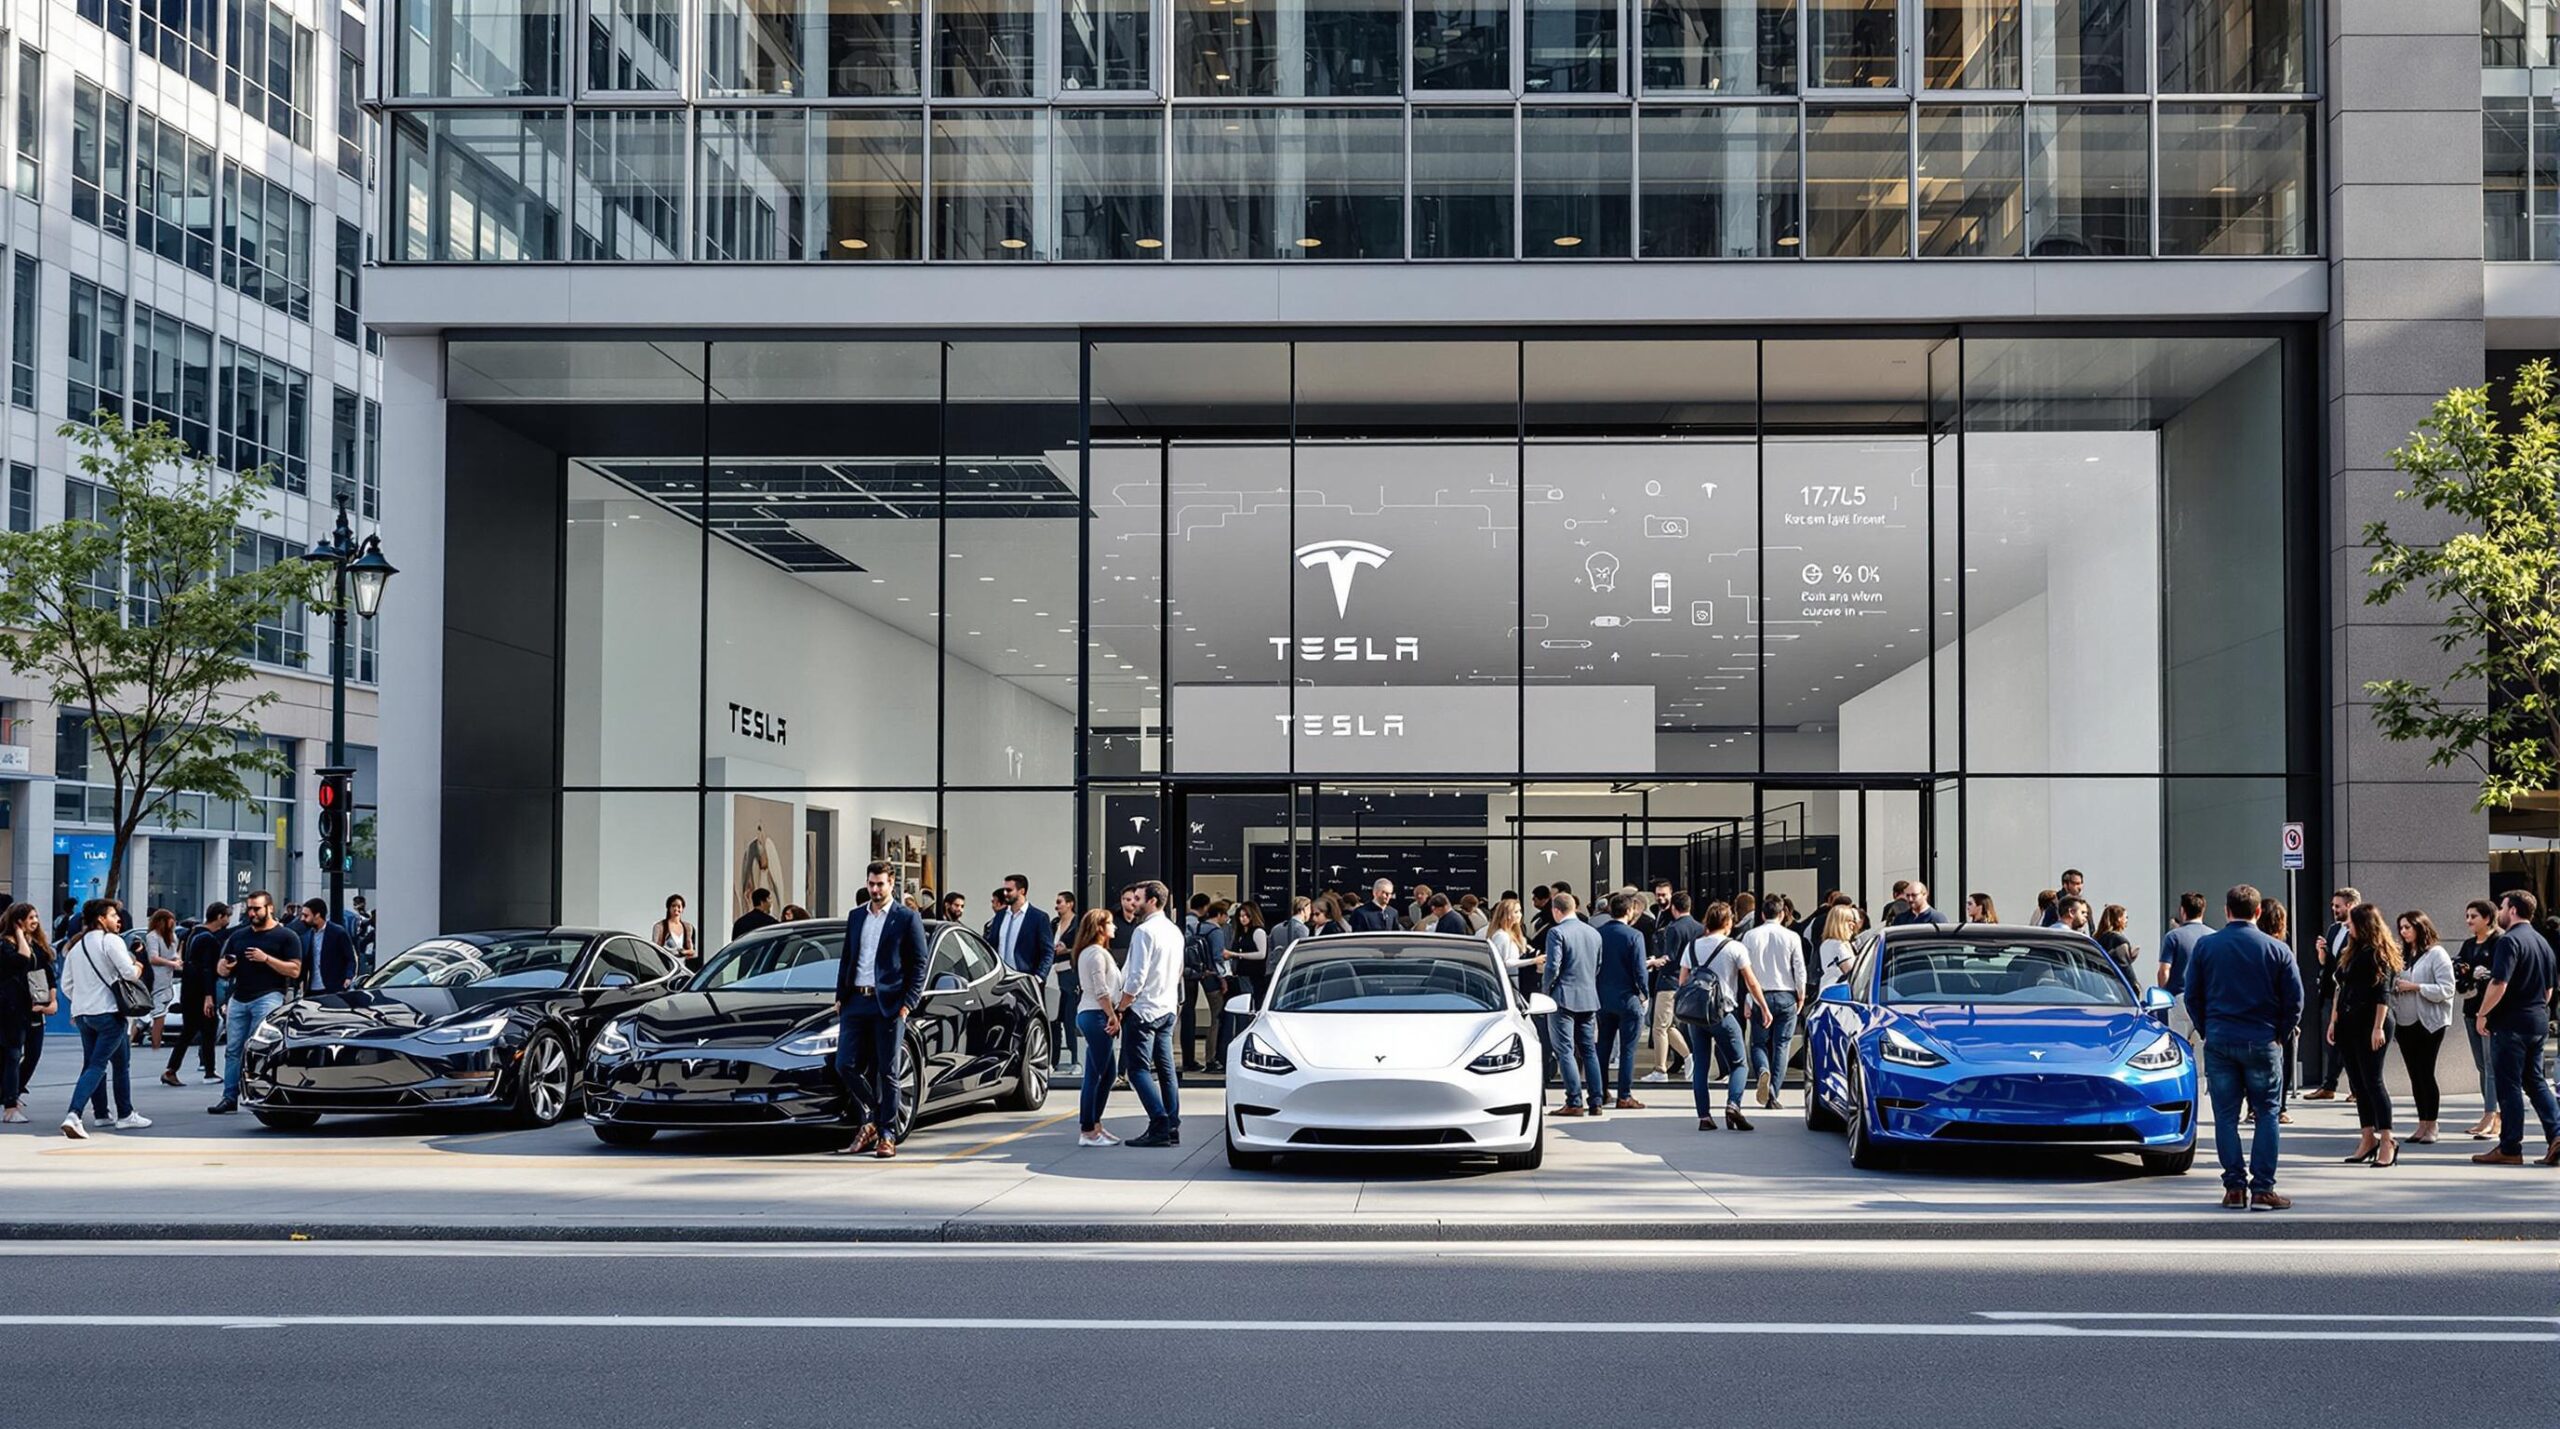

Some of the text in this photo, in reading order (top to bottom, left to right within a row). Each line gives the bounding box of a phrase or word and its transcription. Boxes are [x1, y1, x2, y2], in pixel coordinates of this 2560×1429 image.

[1268, 637, 1419, 661] TESLA
[728, 701, 787, 746] TESLA
[1275, 715, 1404, 736] TESLA
